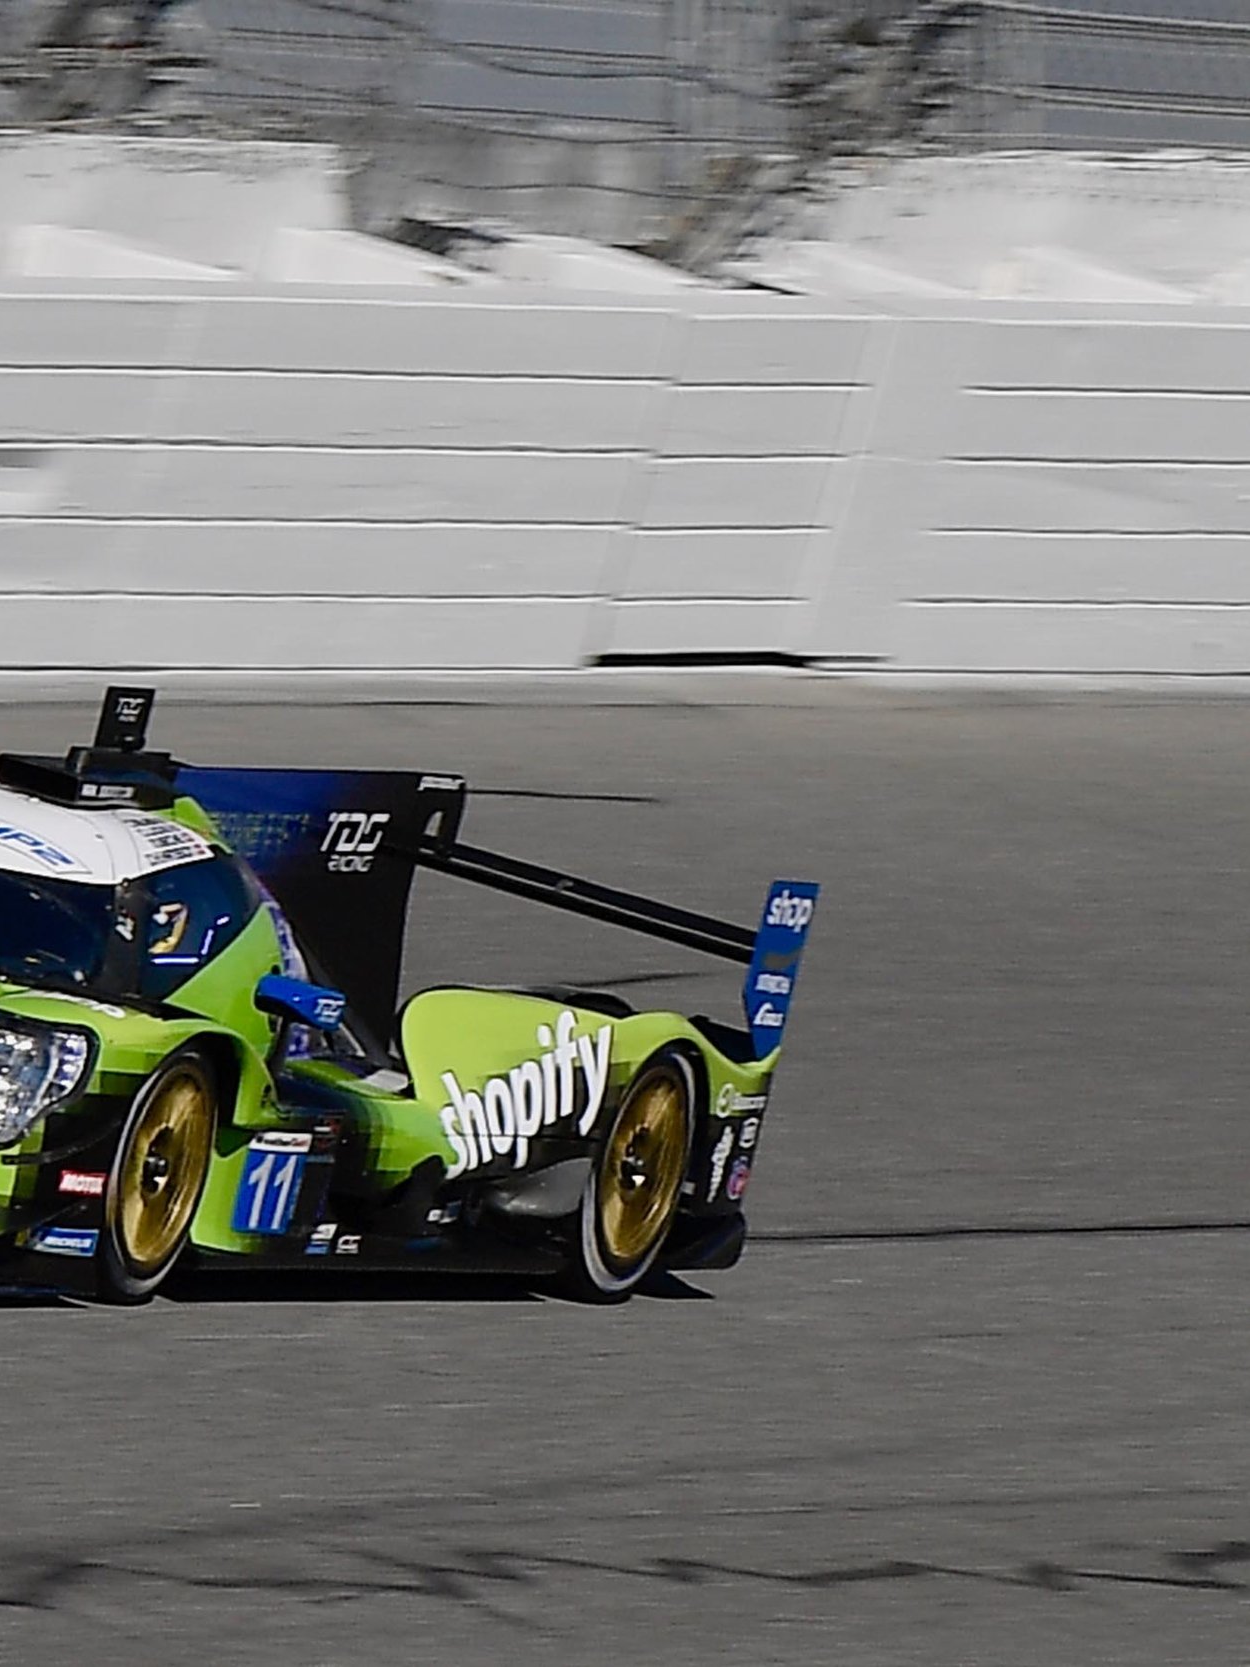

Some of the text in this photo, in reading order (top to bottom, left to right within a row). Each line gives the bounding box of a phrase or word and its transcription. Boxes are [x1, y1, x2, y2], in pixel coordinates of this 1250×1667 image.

[320, 813, 391, 852] TDS
[766, 890, 814, 933] shop
[440, 1010, 613, 1180] shopify
[248, 1153, 299, 1230] 11
